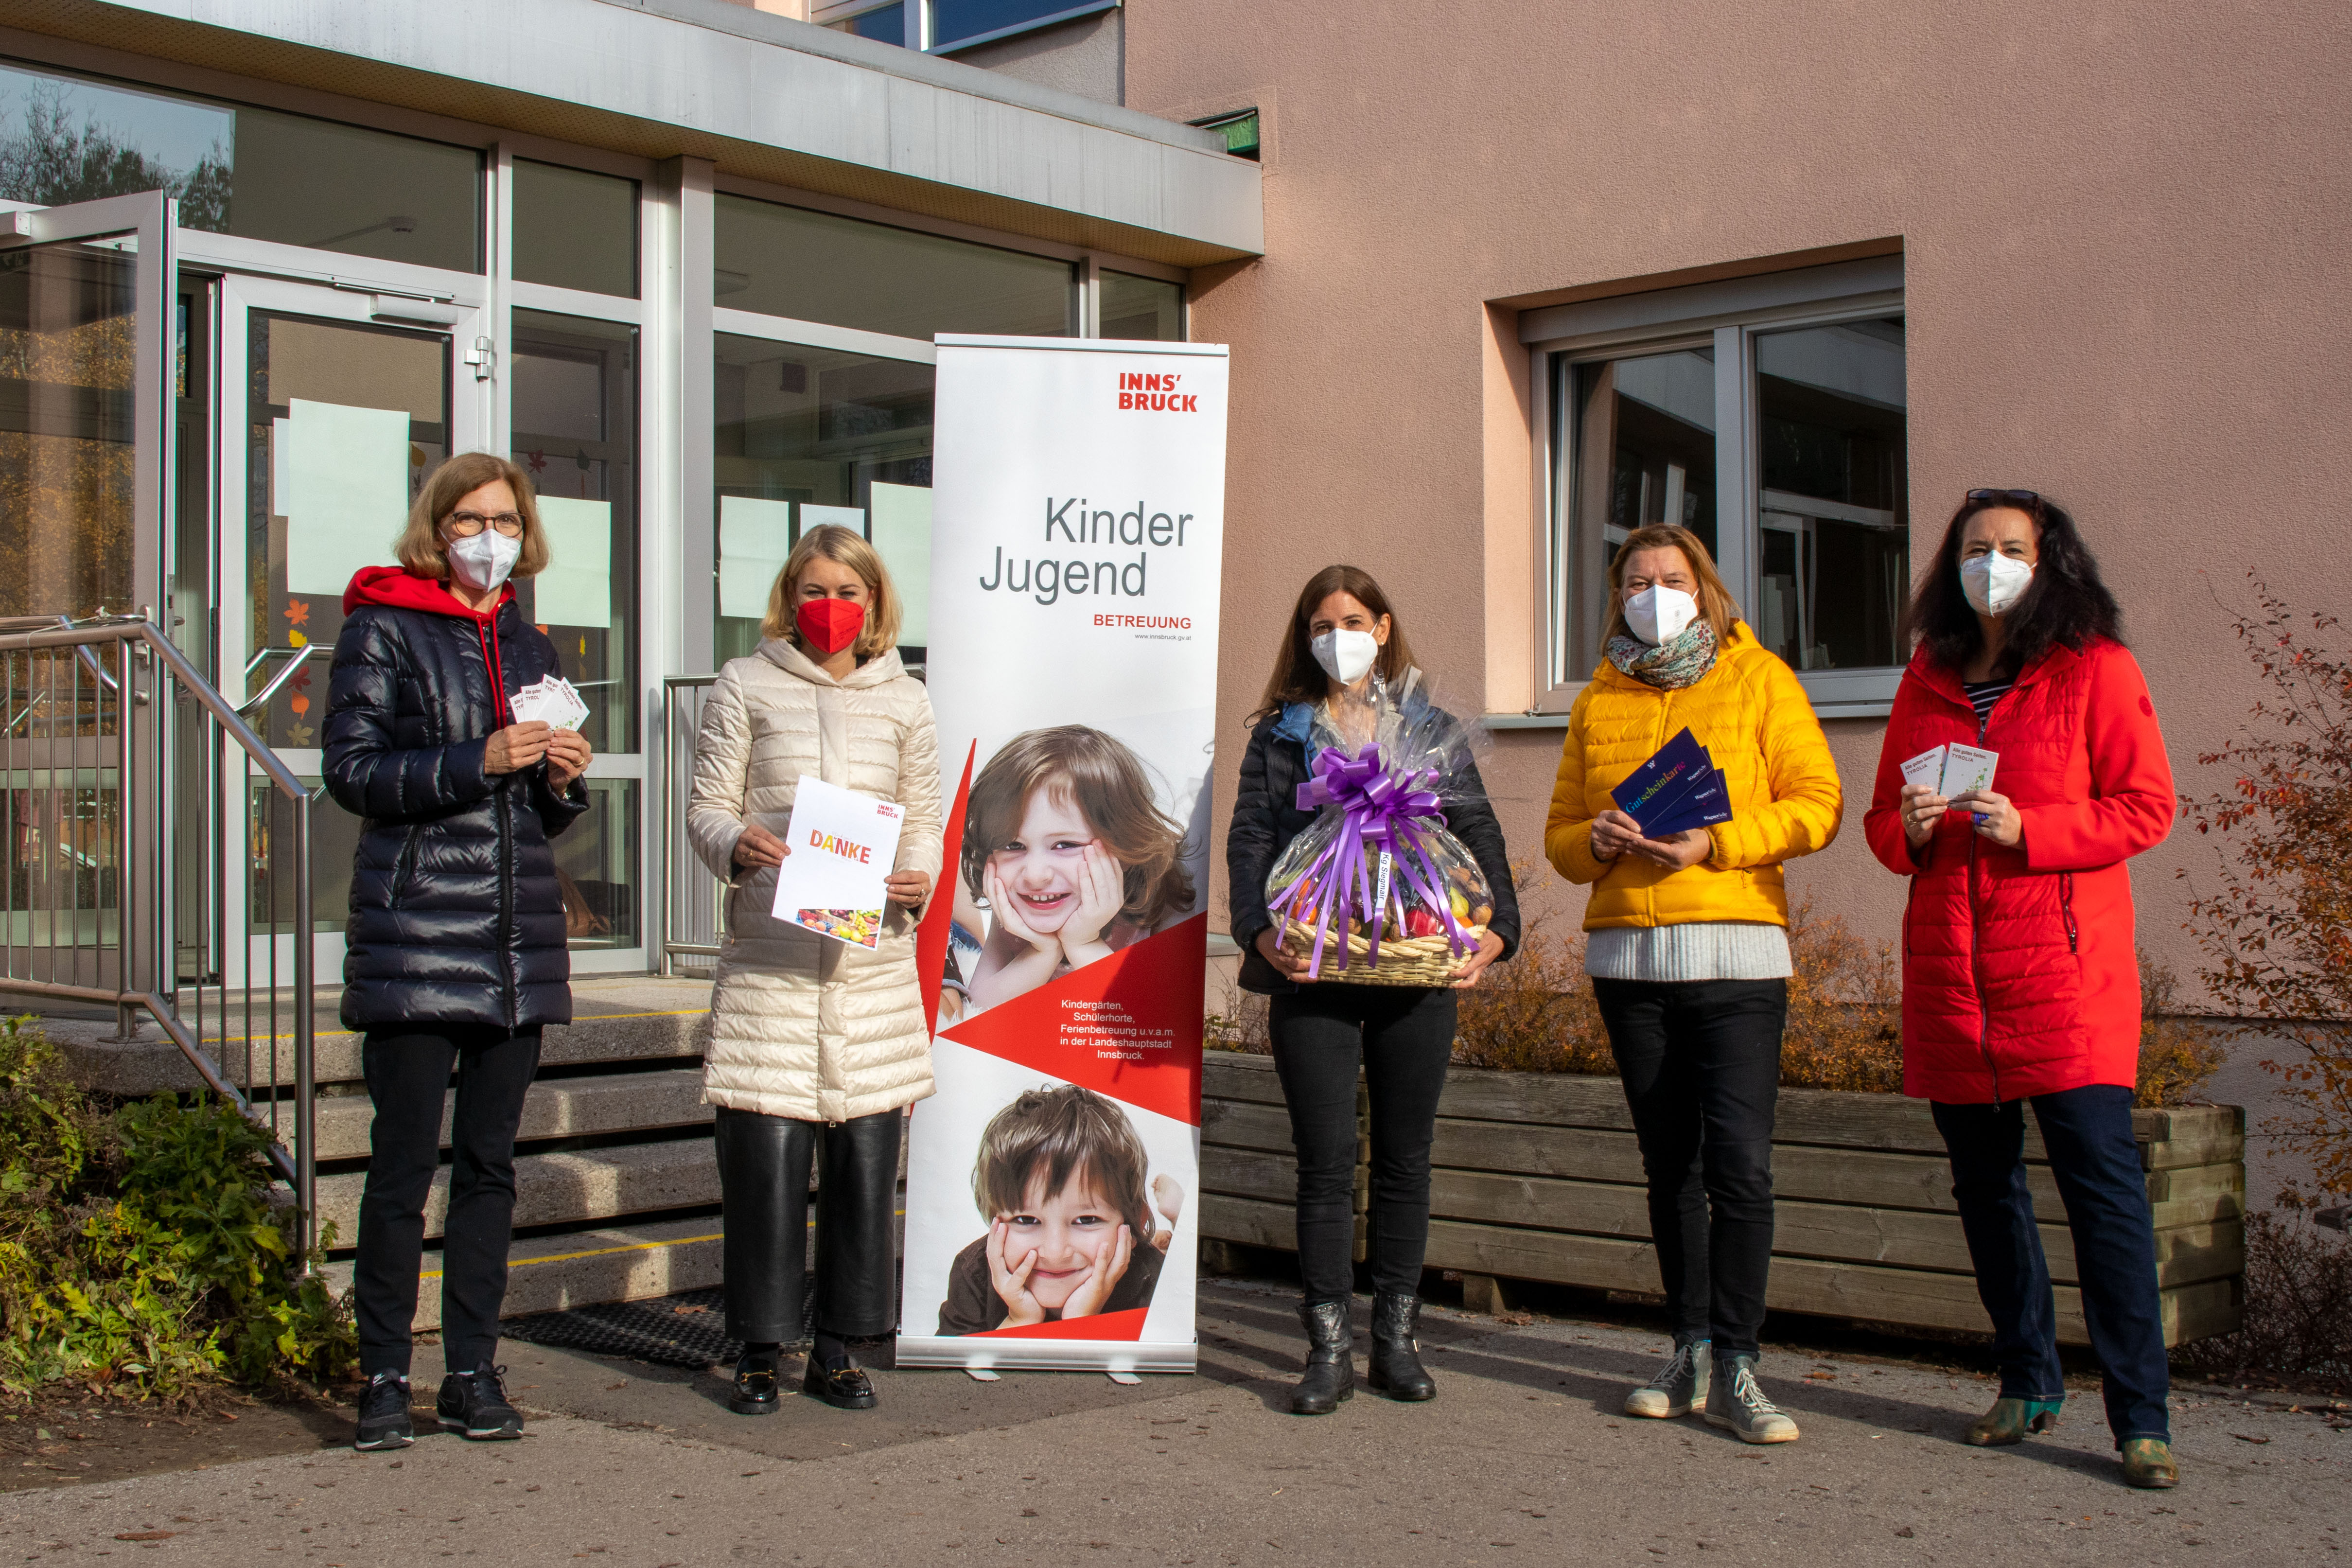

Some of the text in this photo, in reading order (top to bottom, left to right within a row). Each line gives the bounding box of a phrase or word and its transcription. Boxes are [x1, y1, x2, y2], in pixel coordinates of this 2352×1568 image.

[1118, 392, 1197, 412] BRUCK
[1045, 497, 1194, 547] Kinder
[980, 546, 1146, 605] Jugend
[1094, 614, 1192, 629] BETREUUNG
[561, 687, 573, 705] TYROLIA
[1951, 753, 1973, 762] TYROLIA
[1907, 764, 1928, 775] TYROLIA
[1626, 761, 1686, 813] Gutscheinkarte
[877, 809, 898, 819] BRUCK
[809, 828, 871, 864] DANKE
[1379, 853, 1389, 900] Kg Siegmair
[1062, 1000, 1123, 1011] Kindergärten,
[1073, 1012, 1135, 1023] Schülerhorte,
[1060, 1024, 1137, 1037] Ferienbetreuung
[1060, 1037, 1172, 1049] in der Landeshauptstadt
[1097, 1050, 1144, 1059] Innsbruck.
